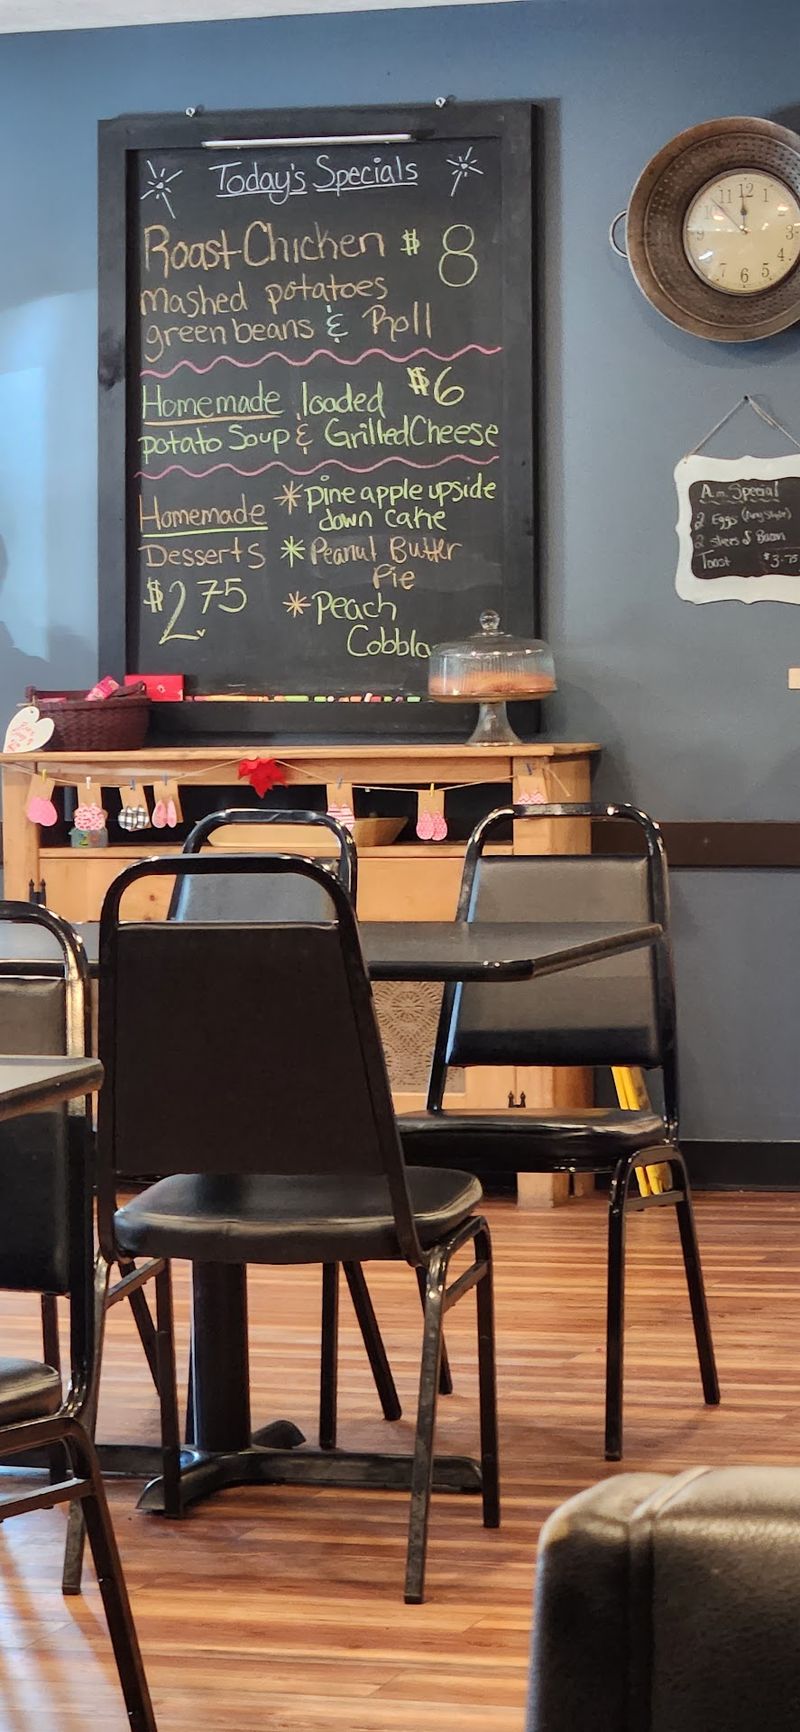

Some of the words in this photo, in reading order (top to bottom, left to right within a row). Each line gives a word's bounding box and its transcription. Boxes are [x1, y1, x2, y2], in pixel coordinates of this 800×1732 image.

[209, 162, 307, 205] Today's
[312, 154, 419, 197] Specials
[739, 182, 753, 198] 12
[719, 189, 732, 203] 11
[763, 188, 769, 203] 1
[785, 224, 794, 241] 3
[144, 223, 242, 279] Roast
[243, 220, 385, 268] Chicken
[777, 247, 785, 262] 4
[740, 267, 749, 283] 6
[761, 262, 769, 278] 5
[265, 273, 388, 315] potatoes
[144, 324, 227, 363] green
[231, 318, 314, 344] beans
[361, 301, 432, 342] Roll
[142, 380, 285, 419] Homemade
[302, 381, 386, 419] loaded
[138, 427, 222, 465] potato
[228, 424, 291, 455] Soup
[428, 472, 496, 507] upside
[728, 480, 779, 501] Special
[138, 493, 268, 533] Homemade
[318, 508, 373, 531] down
[711, 513, 738, 530] Eggs
[138, 537, 267, 569] Desserts
[310, 535, 377, 566] Peanut
[389, 535, 463, 564] Butter
[696, 549, 731, 570] Toast
[372, 563, 416, 590] Pie
[311, 590, 397, 625] Peach
